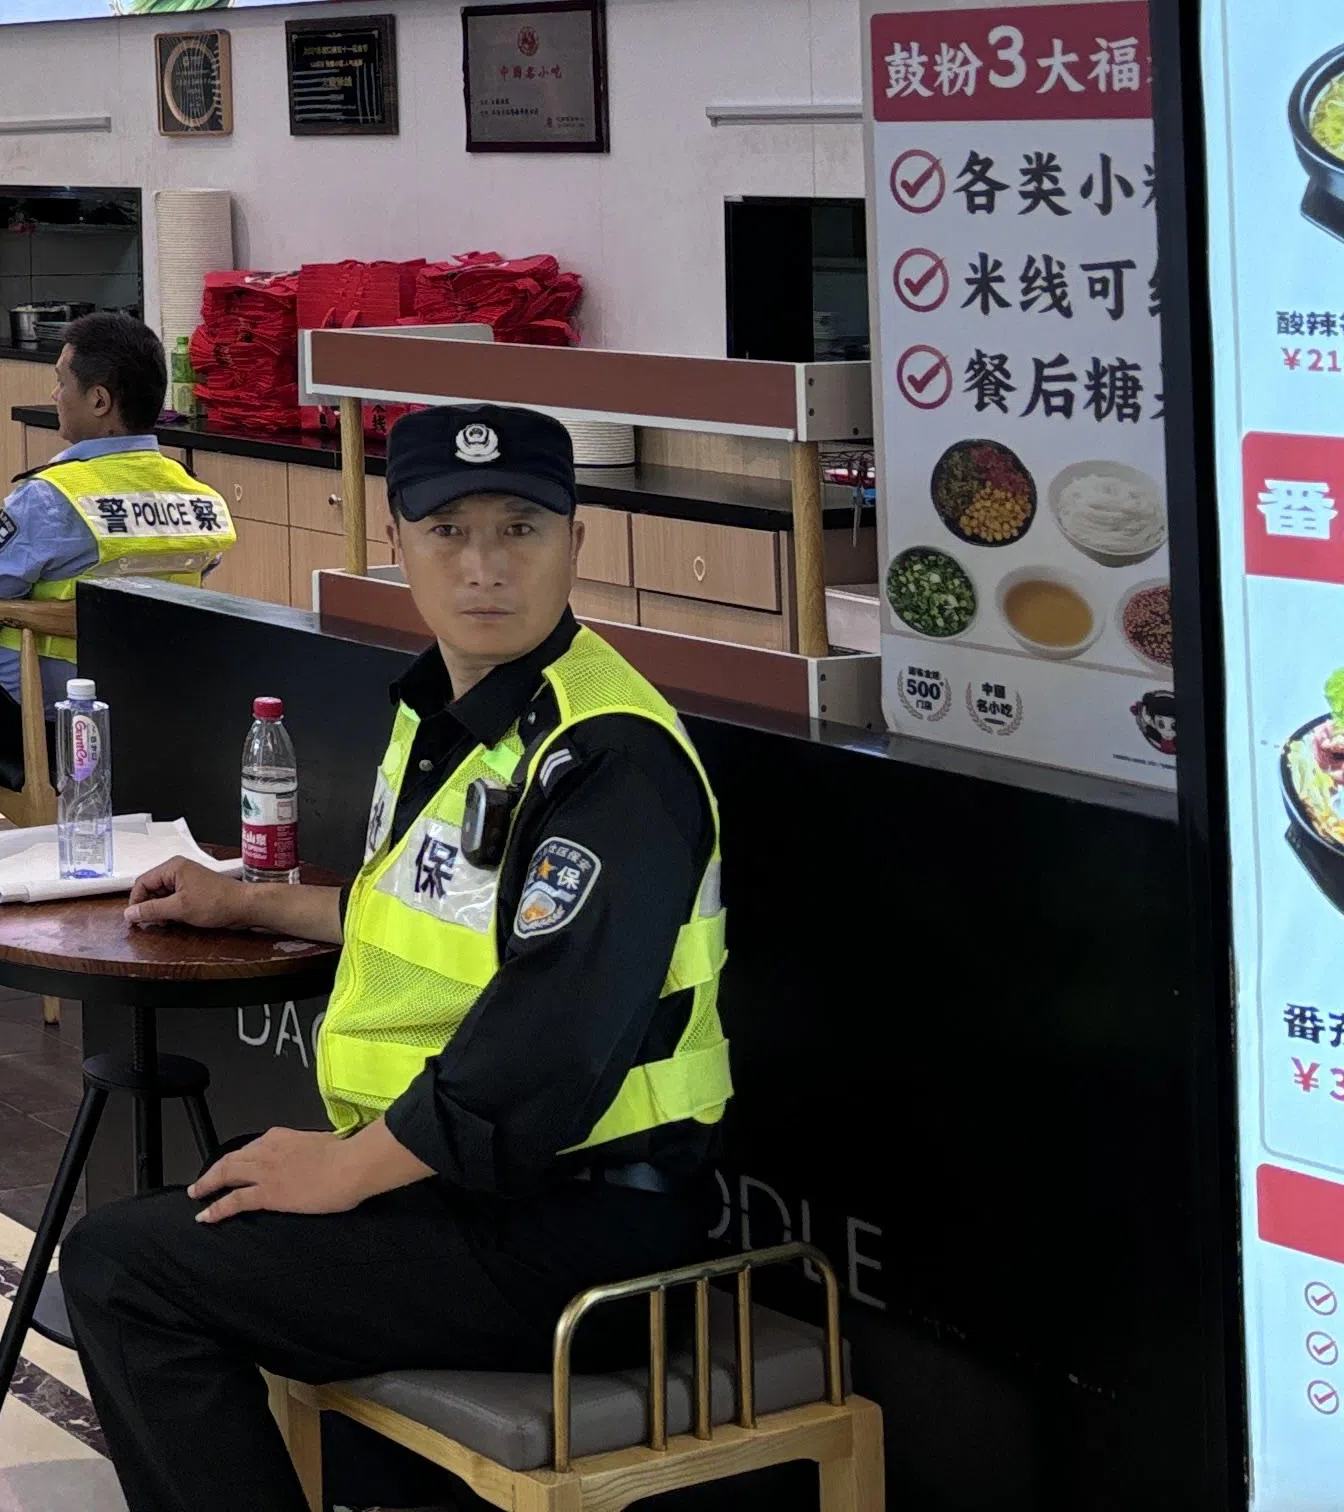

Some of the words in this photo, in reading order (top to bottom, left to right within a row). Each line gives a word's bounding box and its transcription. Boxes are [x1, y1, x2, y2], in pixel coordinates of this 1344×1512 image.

[883, 26, 1153, 99] 鼓粉3大福
[1275, 310, 1344, 338] 酸辣
[962, 348, 1166, 424] 餐后糖
[95, 497, 128, 533] 警
[131, 502, 192, 527] POLICE
[189, 498, 222, 530] 察
[414, 833, 458, 900] 保
[556, 866, 581, 891] 保
